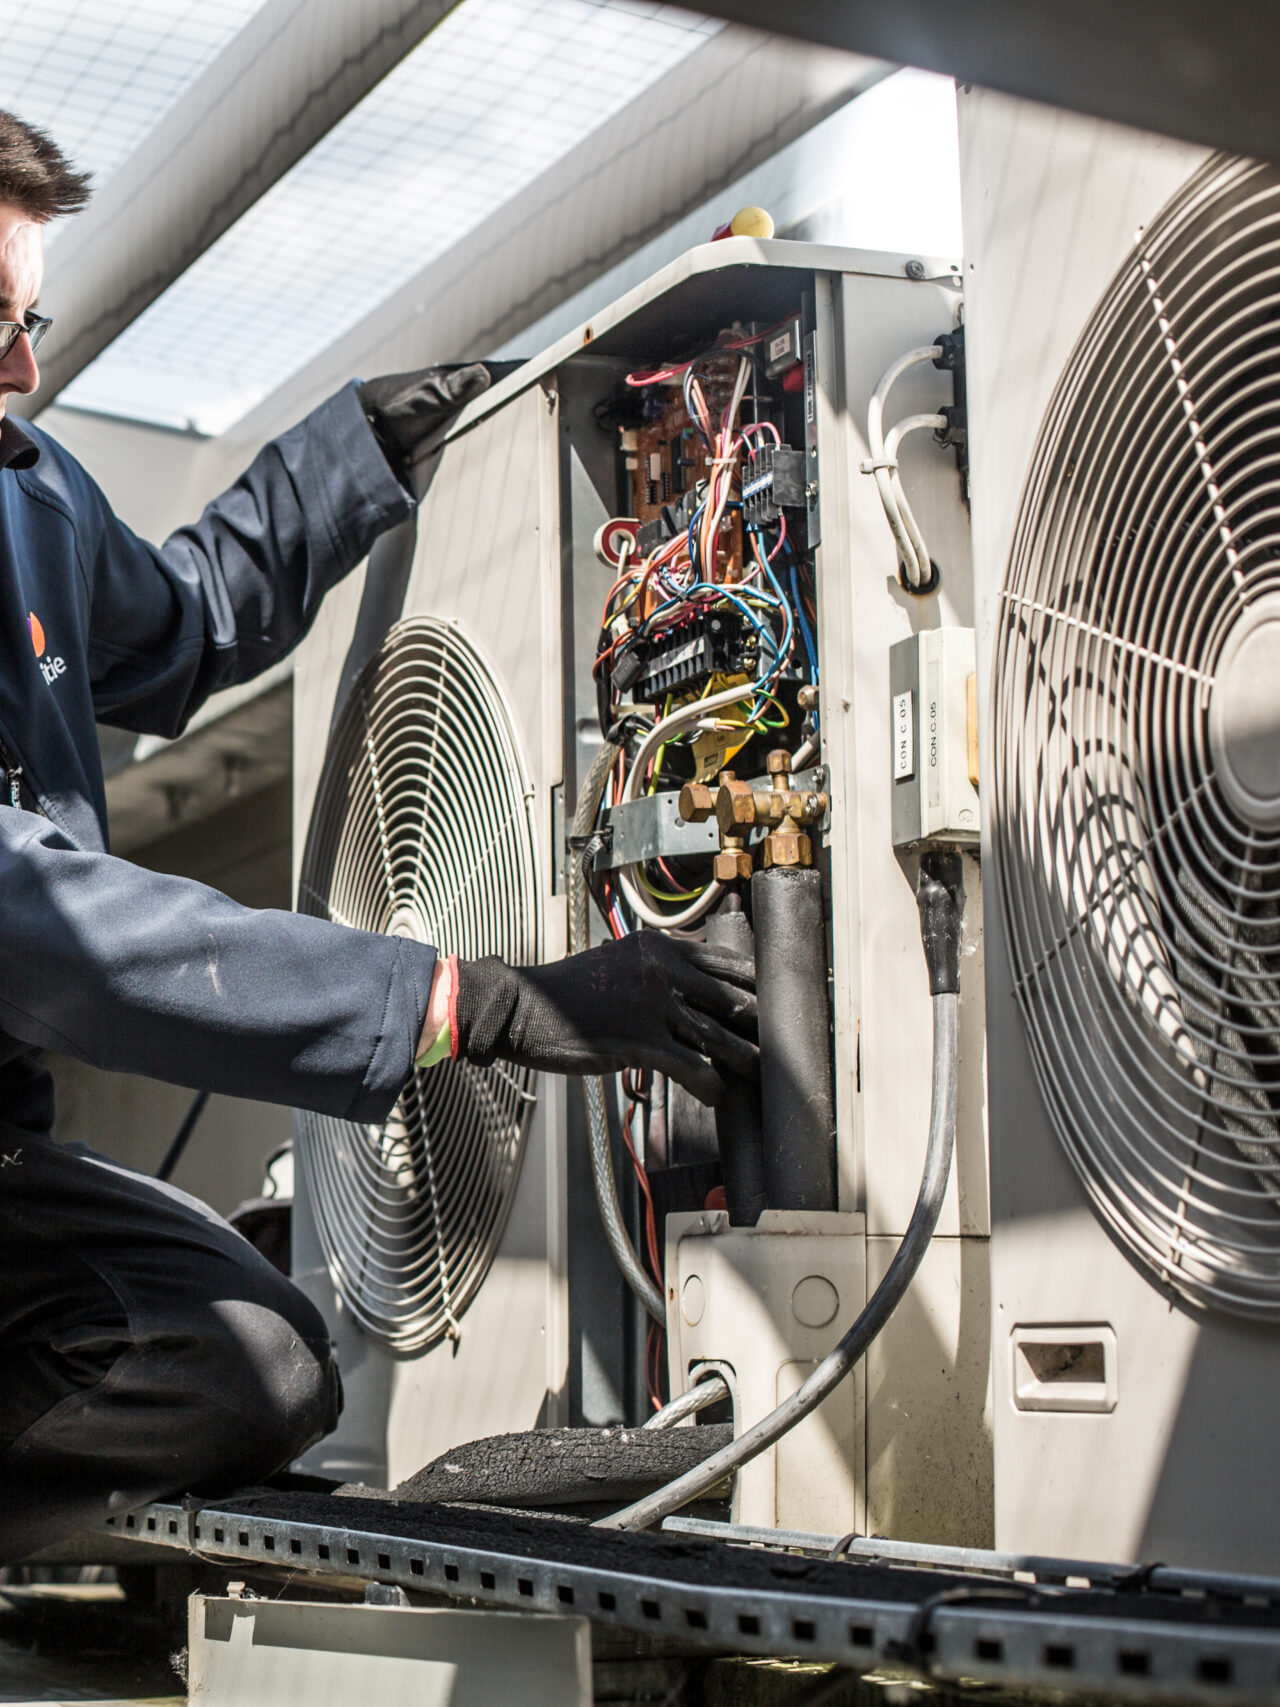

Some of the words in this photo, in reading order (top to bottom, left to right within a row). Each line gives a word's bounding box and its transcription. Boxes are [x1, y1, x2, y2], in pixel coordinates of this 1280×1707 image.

[39, 655, 67, 686] itie
[900, 699, 907, 718] 05
[900, 725, 907, 733] C
